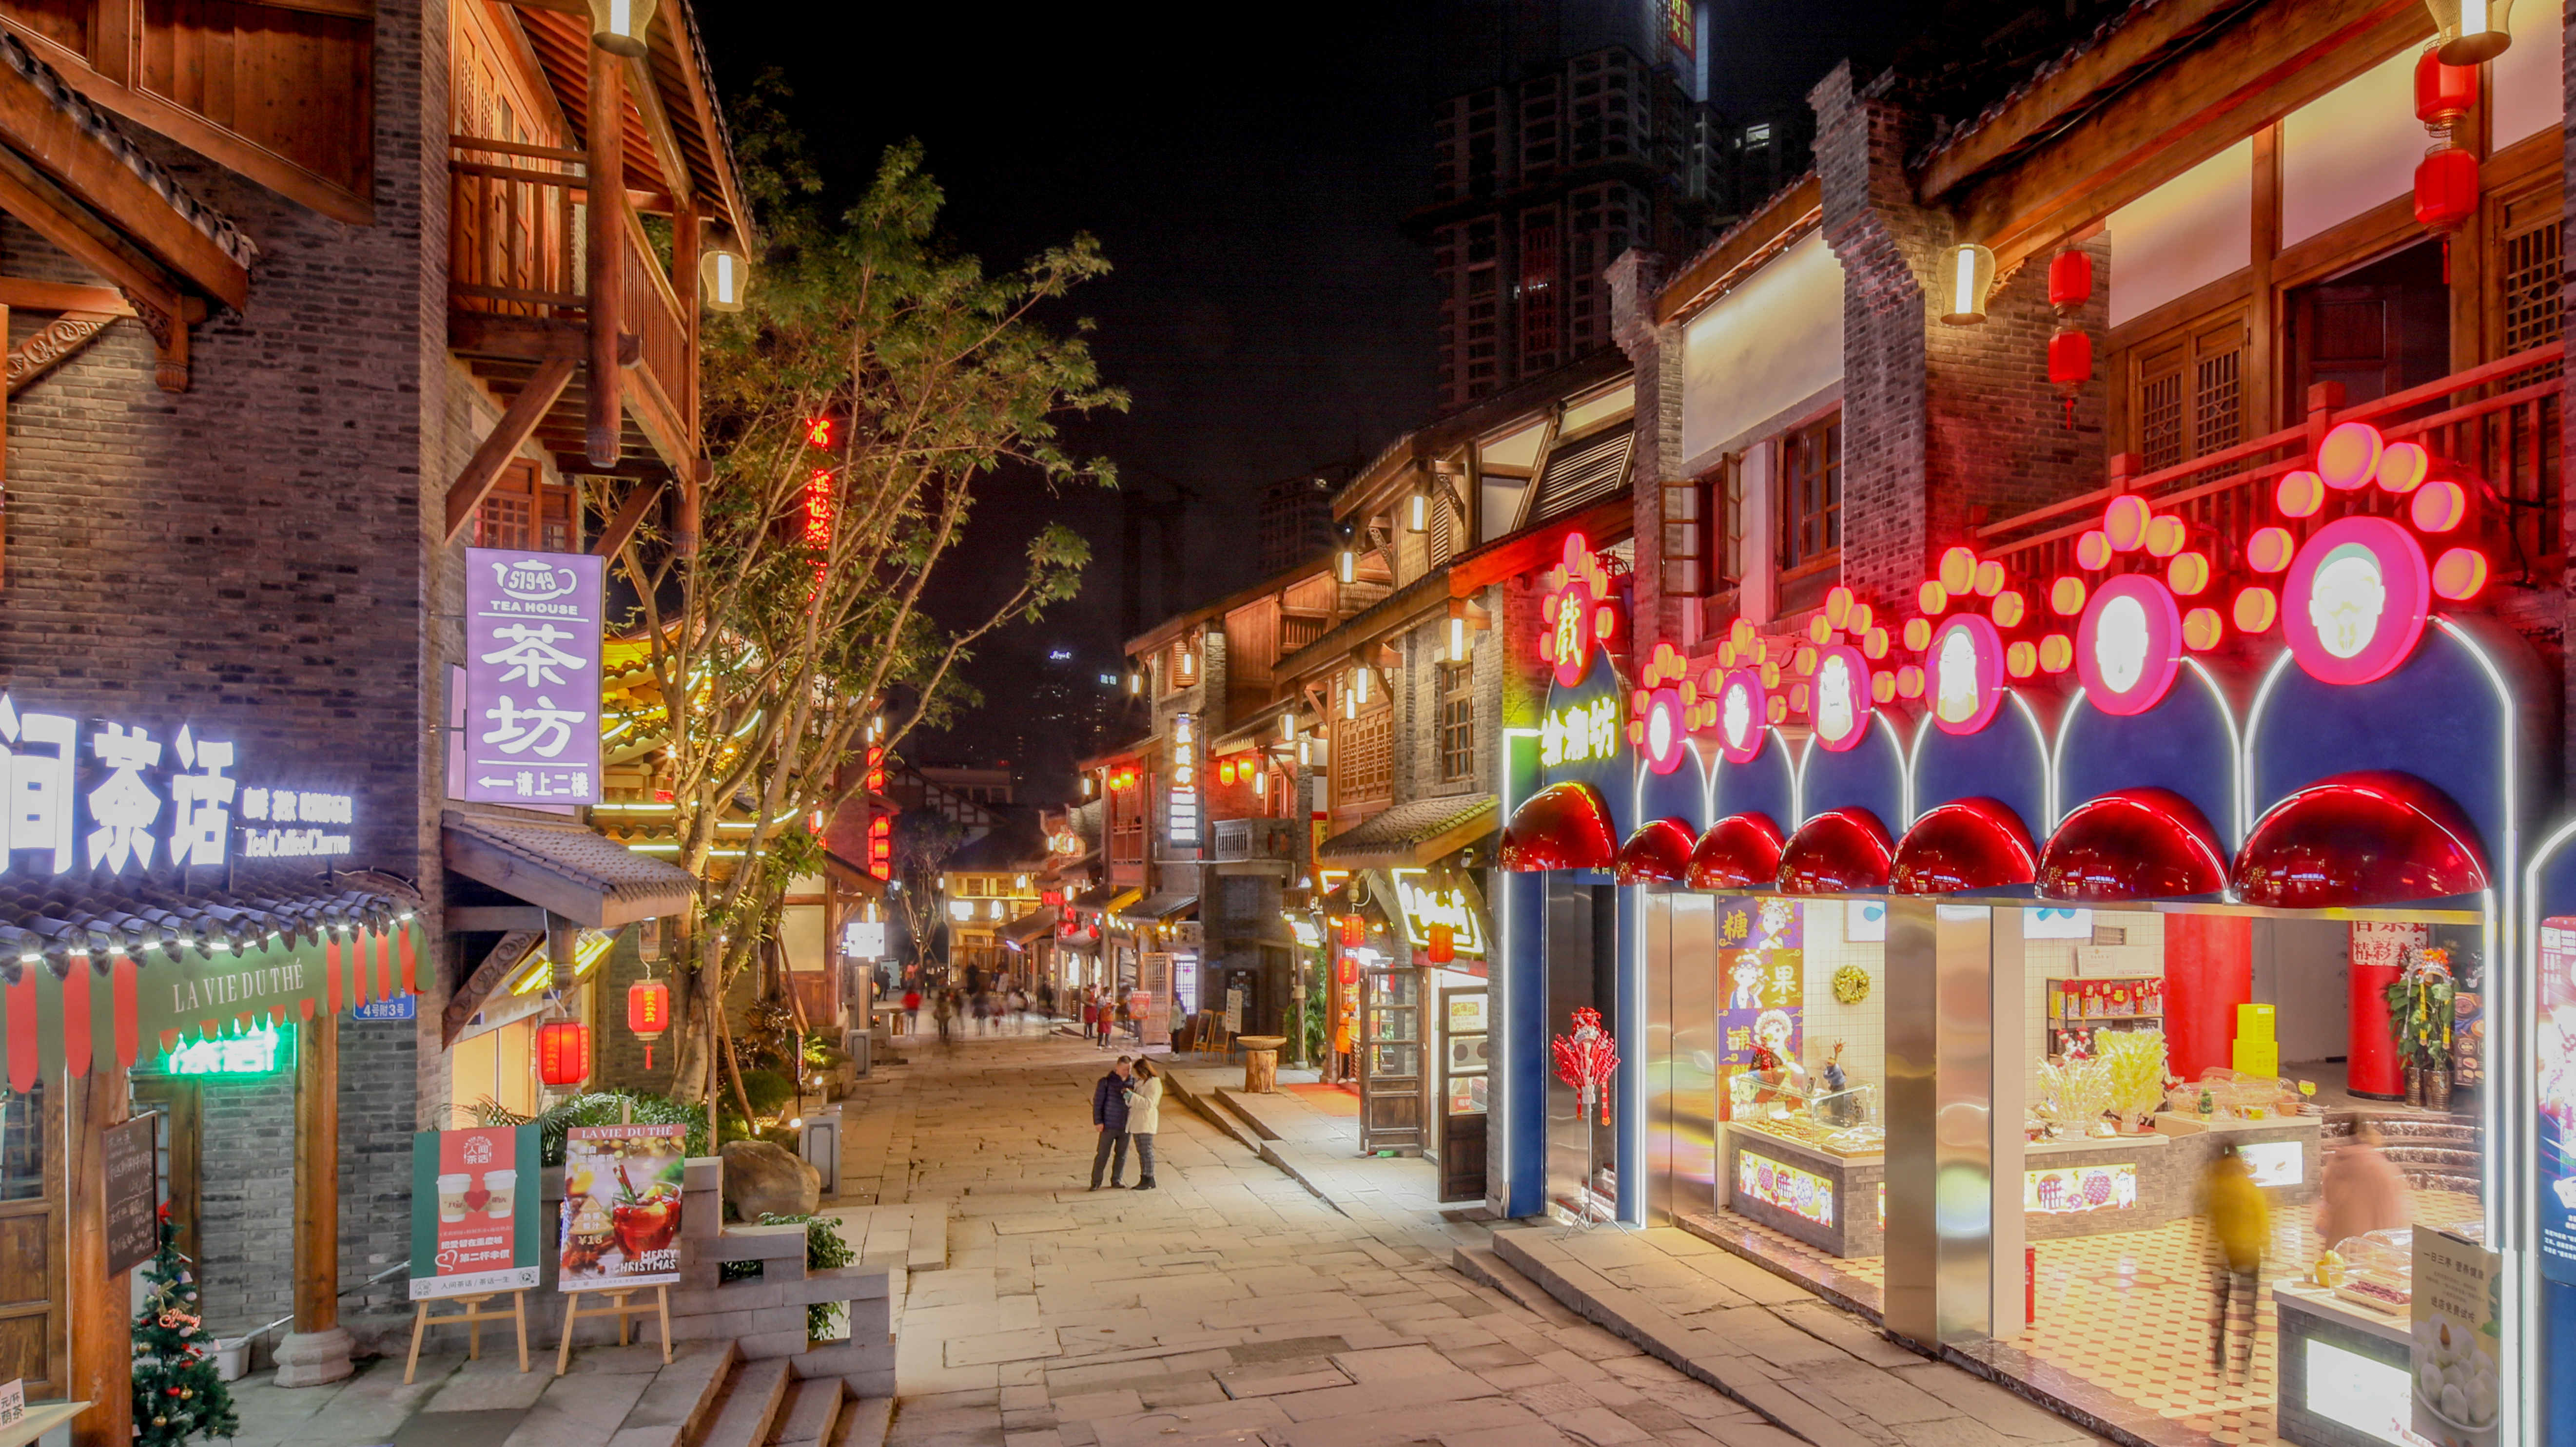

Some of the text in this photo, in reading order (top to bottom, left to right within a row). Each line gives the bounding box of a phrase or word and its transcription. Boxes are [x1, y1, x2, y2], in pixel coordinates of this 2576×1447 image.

[508, 570, 557, 591] S1949
[490, 600, 578, 616] TEA HOUSE
[481, 622, 587, 758] 茶坊
[0, 693, 236, 876] 间茶话
[1722, 909, 1749, 942] 糖
[173, 958, 304, 1014] LA VIE DU THÉ
[1771, 965, 1796, 995] 果
[363, 1003, 405, 1017] 4号附3号
[582, 1129, 598, 1139] LA
[600, 1128, 622, 1138] VIE
[627, 1127, 646, 1137] DU
[578, 1235, 603, 1245] ¥18
[641, 1248, 677, 1261] MERRY
[613, 1259, 677, 1273] CHRISTMAS
